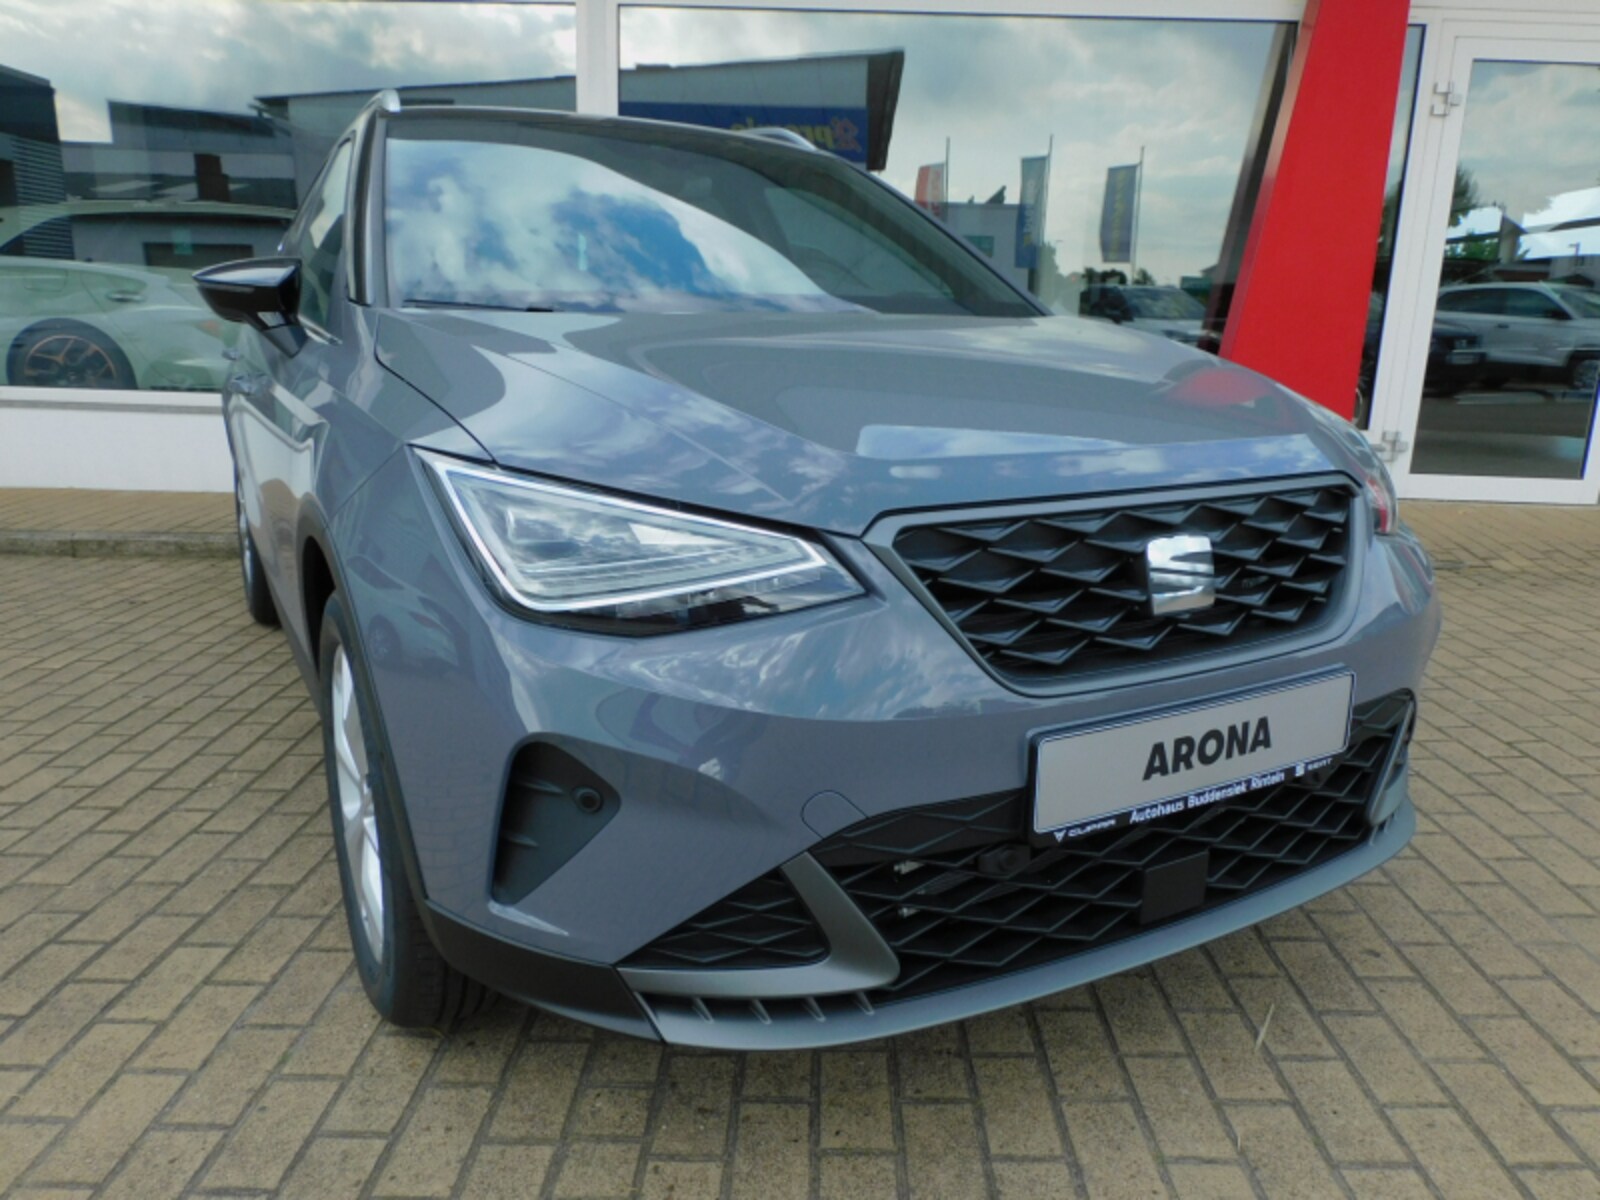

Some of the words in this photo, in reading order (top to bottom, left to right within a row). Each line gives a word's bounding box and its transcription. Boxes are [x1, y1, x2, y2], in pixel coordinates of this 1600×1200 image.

[1142, 716, 1272, 781] ARONA
[1129, 799, 1185, 824] Autohaus
[1187, 781, 1247, 808] Buddensiek
